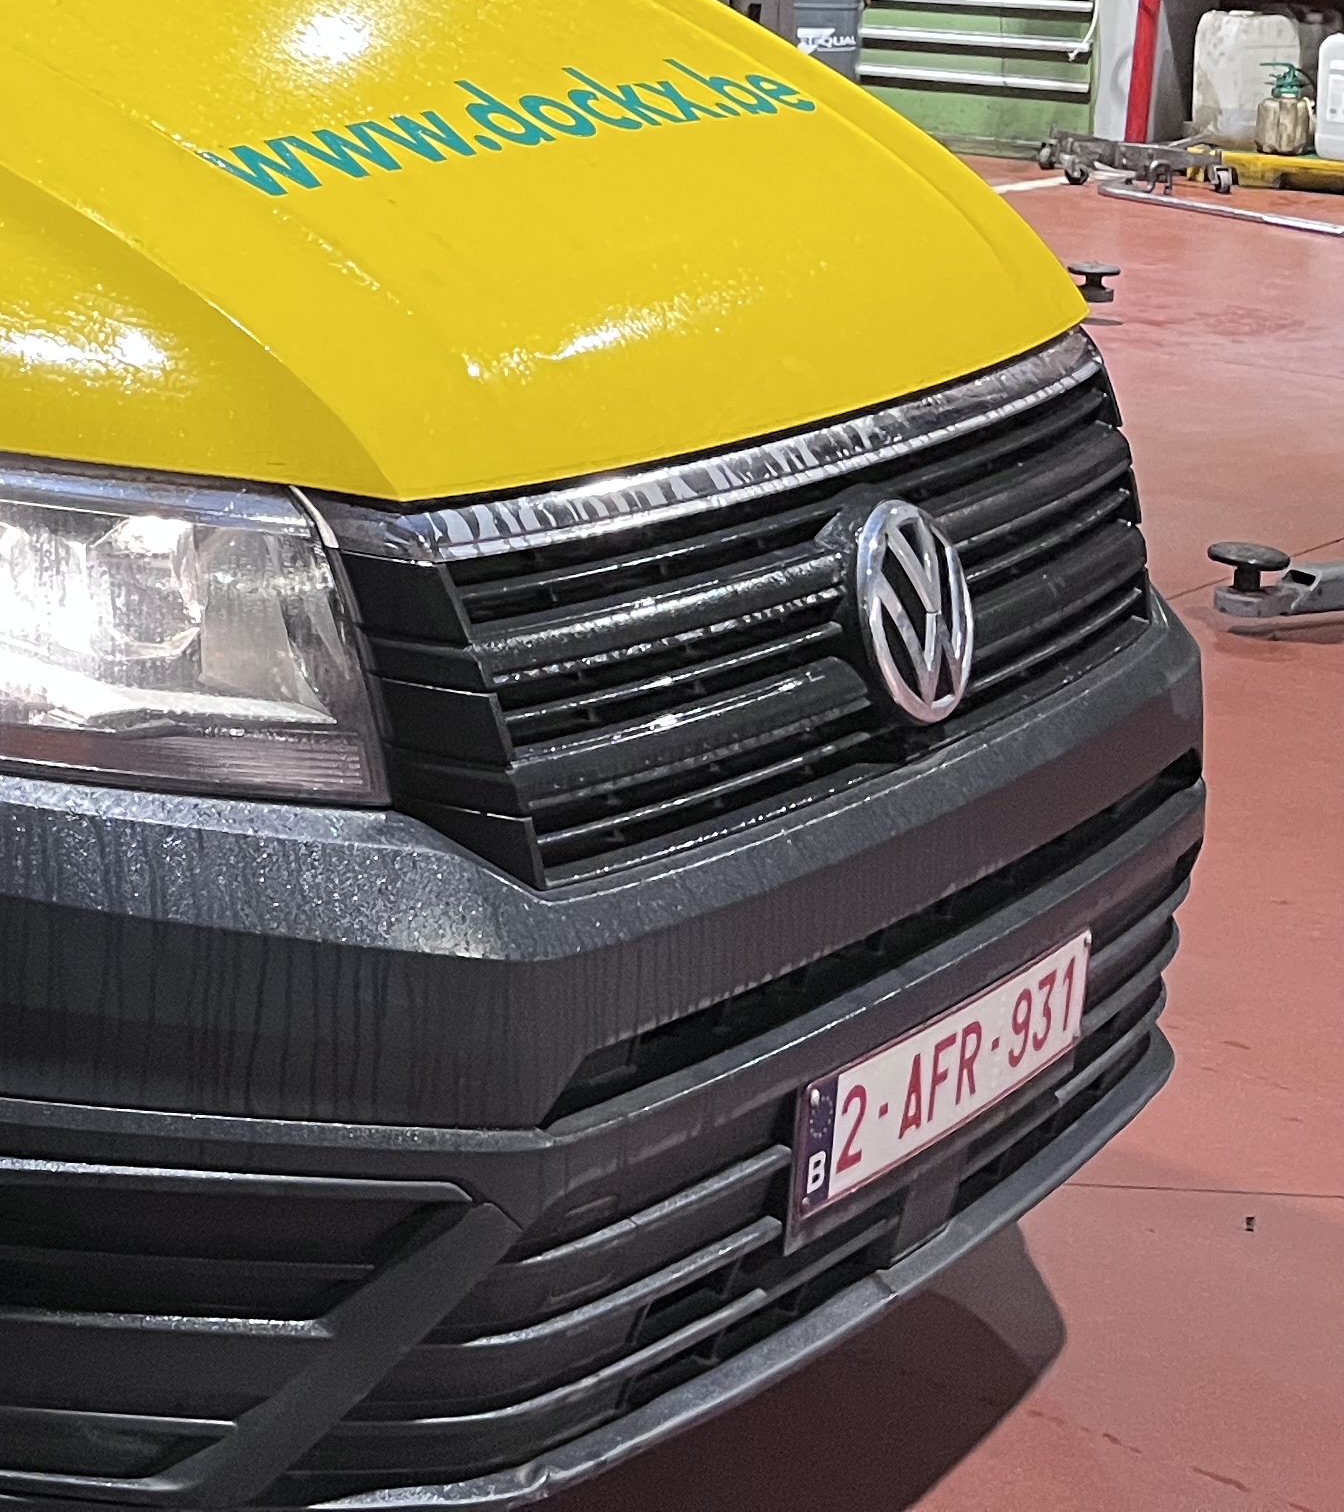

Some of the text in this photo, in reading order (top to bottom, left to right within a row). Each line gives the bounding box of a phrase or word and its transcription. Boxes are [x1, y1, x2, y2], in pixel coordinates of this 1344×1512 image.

[195, 58, 816, 197] www.dockx.be
[835, 956, 1076, 1175] 2-AFR-931
[806, 1150, 827, 1194] B
